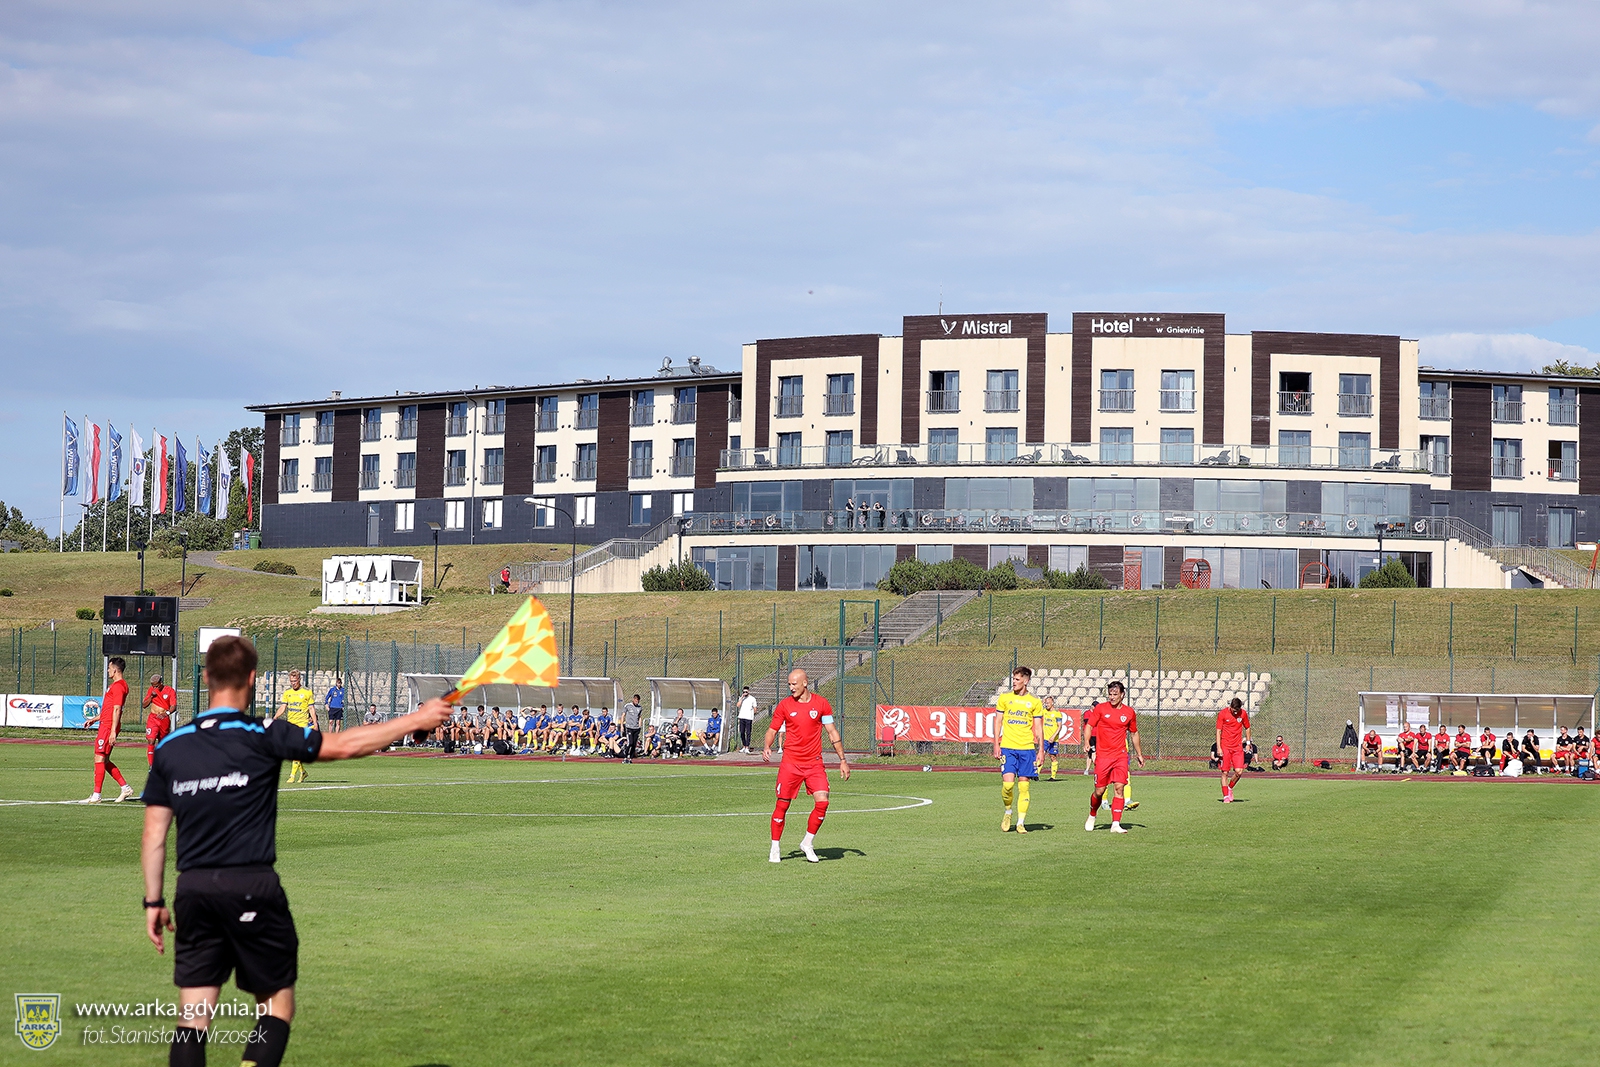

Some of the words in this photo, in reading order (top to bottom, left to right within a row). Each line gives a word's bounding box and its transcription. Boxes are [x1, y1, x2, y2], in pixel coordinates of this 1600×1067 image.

[962, 319, 1012, 335] Mistral
[1091, 318, 1133, 334] Hotel
[1166, 325, 1205, 334] Gniewinie
[102, 624, 137, 636] GOSPODARZE
[150, 623, 171, 637] GOŚCIE
[929, 711, 946, 737] 3
